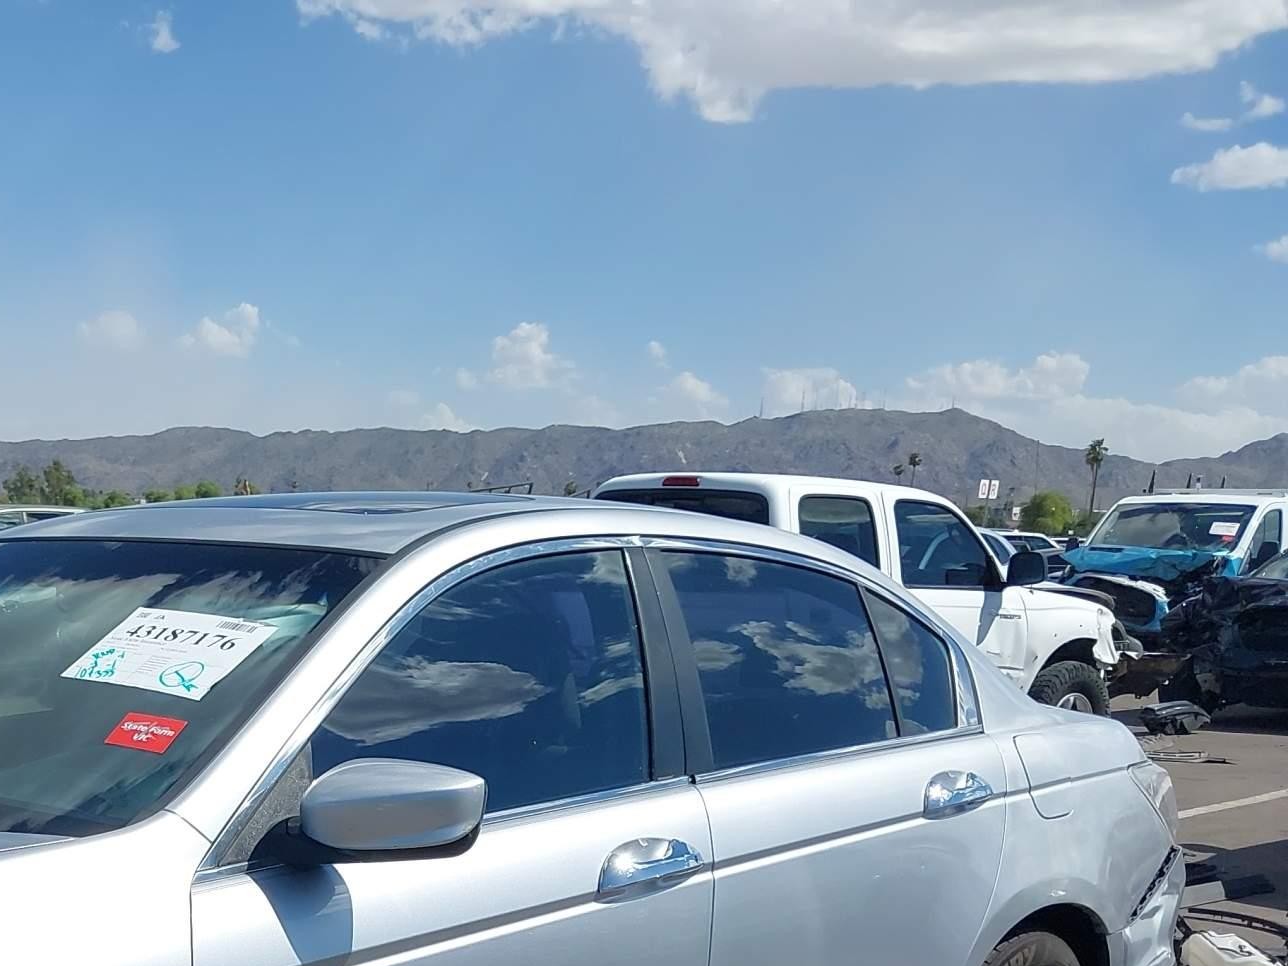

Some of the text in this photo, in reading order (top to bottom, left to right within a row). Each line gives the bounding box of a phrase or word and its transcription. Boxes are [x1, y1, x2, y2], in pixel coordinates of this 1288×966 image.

[125, 624, 243, 651] 43187176
[121, 721, 176, 737] State Farm
